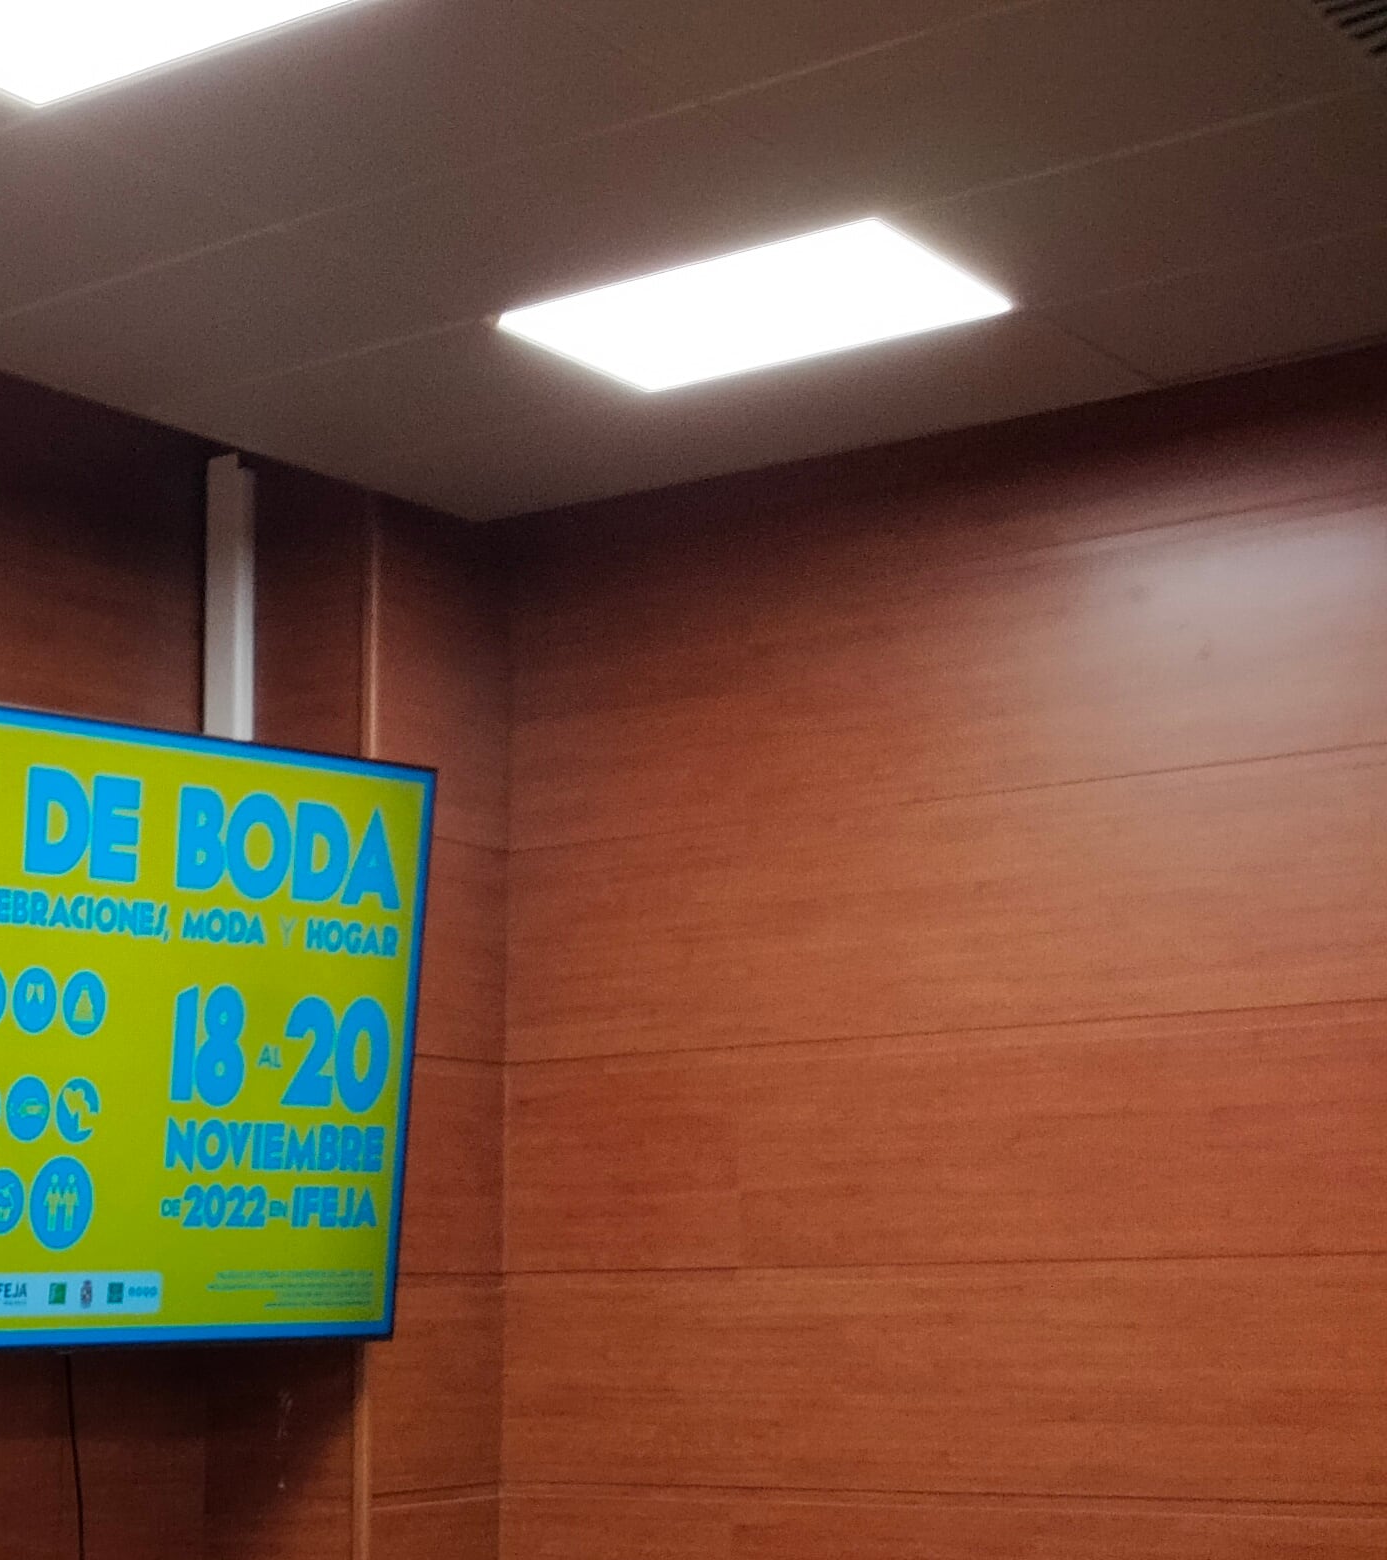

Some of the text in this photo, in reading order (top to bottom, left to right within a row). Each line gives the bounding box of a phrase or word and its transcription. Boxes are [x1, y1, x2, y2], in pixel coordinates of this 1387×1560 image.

[24, 765, 142, 884] DE
[175, 785, 401, 910] BODA
[180, 906, 267, 945] MODA
[277, 914, 297, 946] Y
[304, 916, 400, 957] HOGAR
[170, 983, 391, 1115] 18 AL 20
[164, 1116, 386, 1174] NOVIEMBRE
[160, 1183, 377, 1229] DE 2022 EN IFEJA
